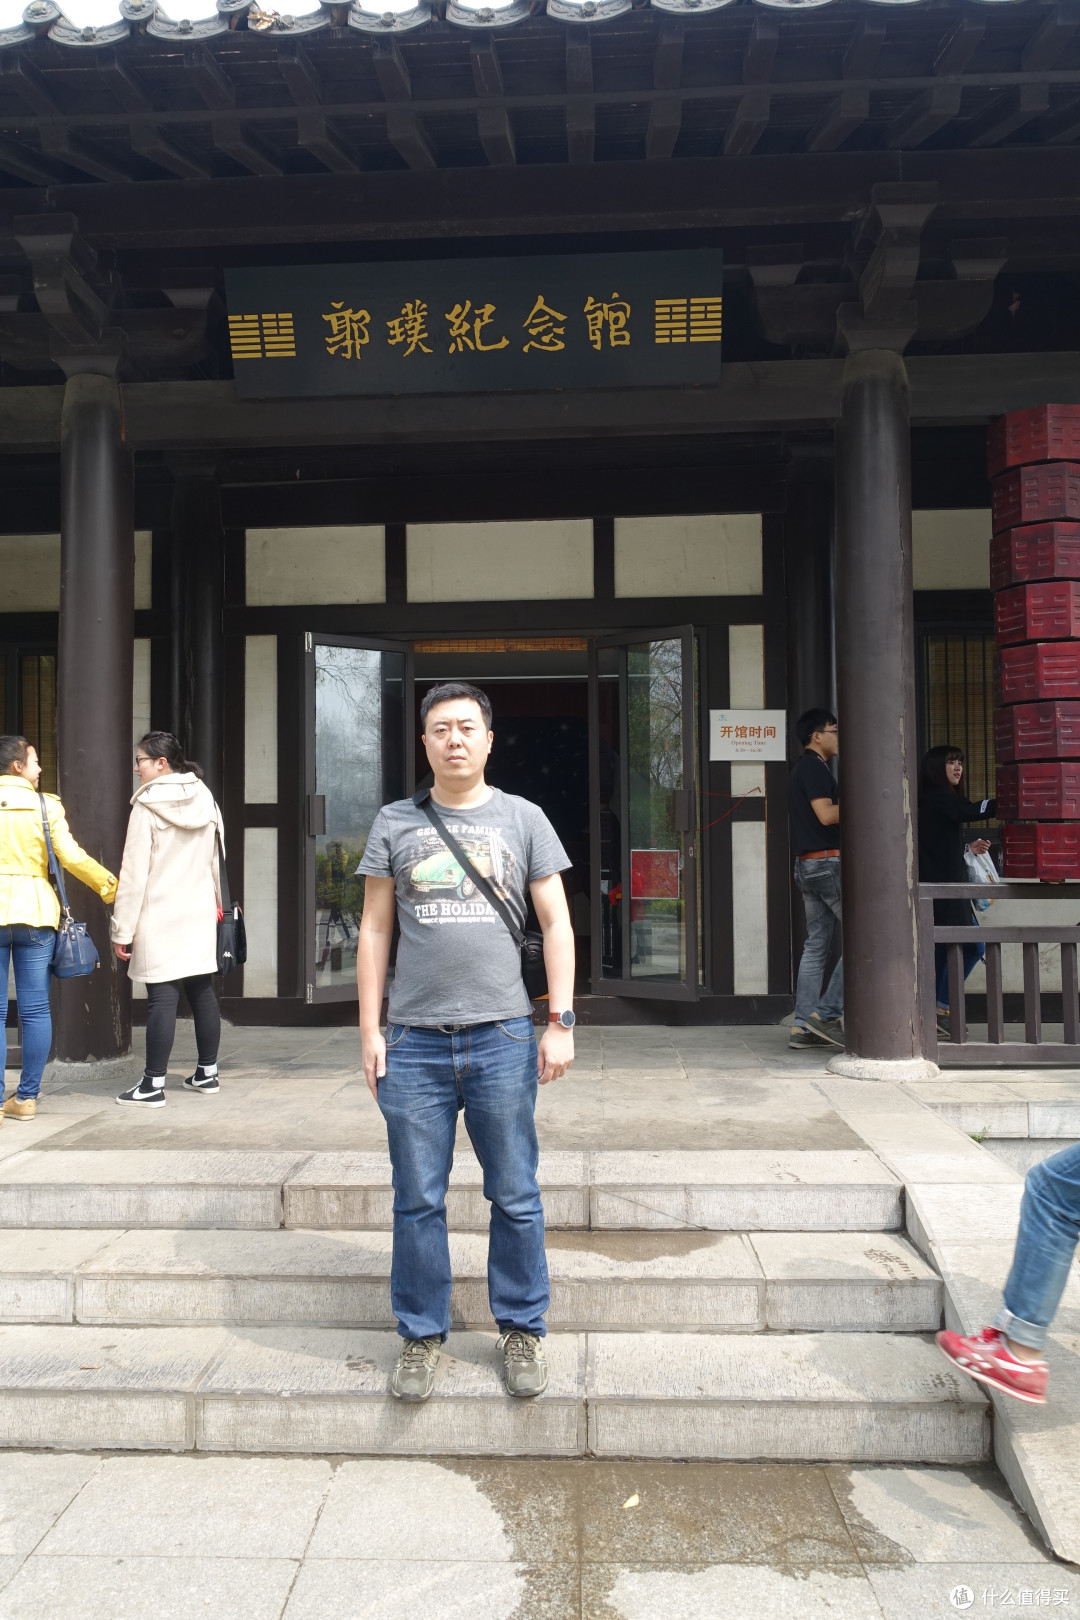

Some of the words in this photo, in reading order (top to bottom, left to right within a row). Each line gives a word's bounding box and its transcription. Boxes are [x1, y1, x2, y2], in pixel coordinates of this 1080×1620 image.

[322, 292, 632, 360] 郭璞紀念館
[720, 725, 776, 739] 开馆时间
[417, 824, 458, 836] GEOGE
[462, 825, 503, 836] FAMILY
[414, 903, 438, 917] THE
[441, 903, 499, 916] HOLIDA
